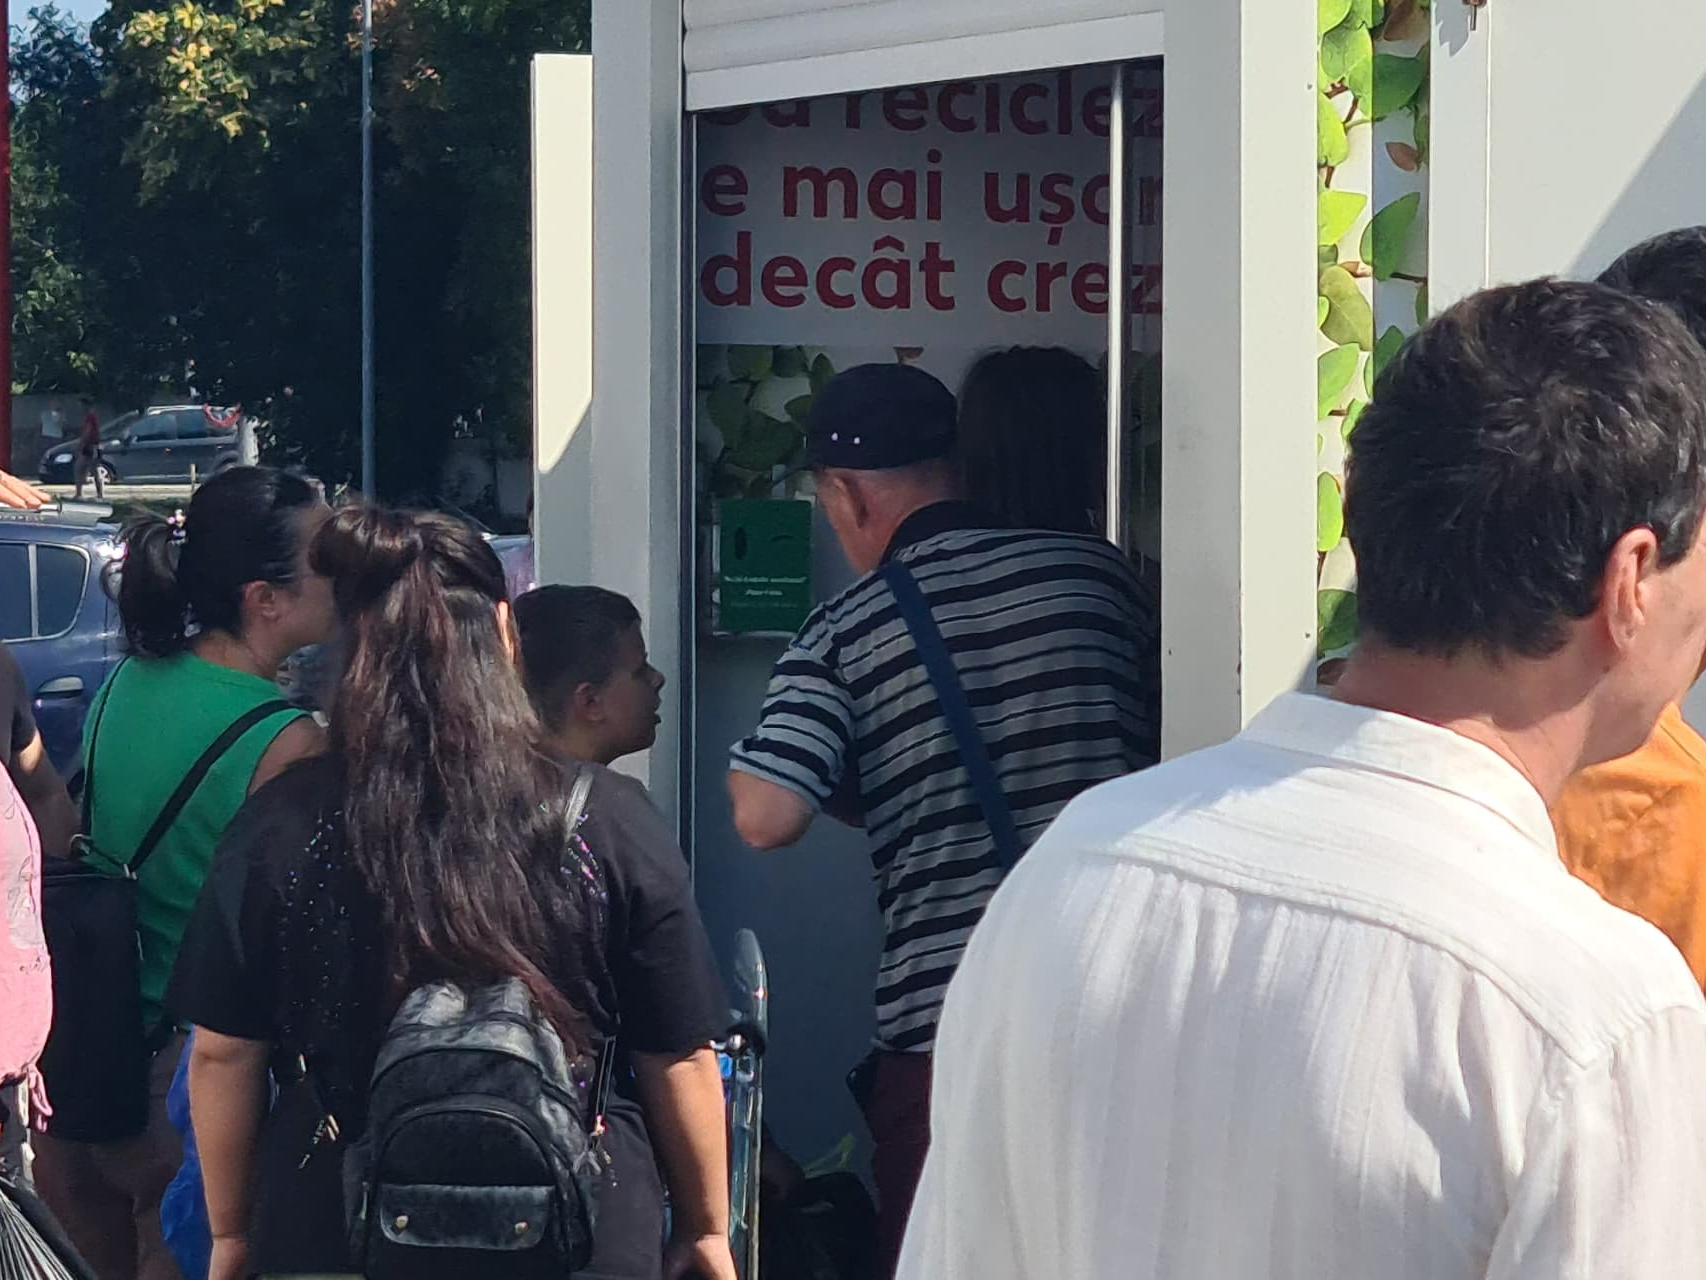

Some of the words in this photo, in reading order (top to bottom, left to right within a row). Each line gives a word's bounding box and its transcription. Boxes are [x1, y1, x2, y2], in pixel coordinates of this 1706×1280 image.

[700, 164, 748, 216] e
[783, 148, 942, 220] mai
[700, 231, 955, 311] decât
